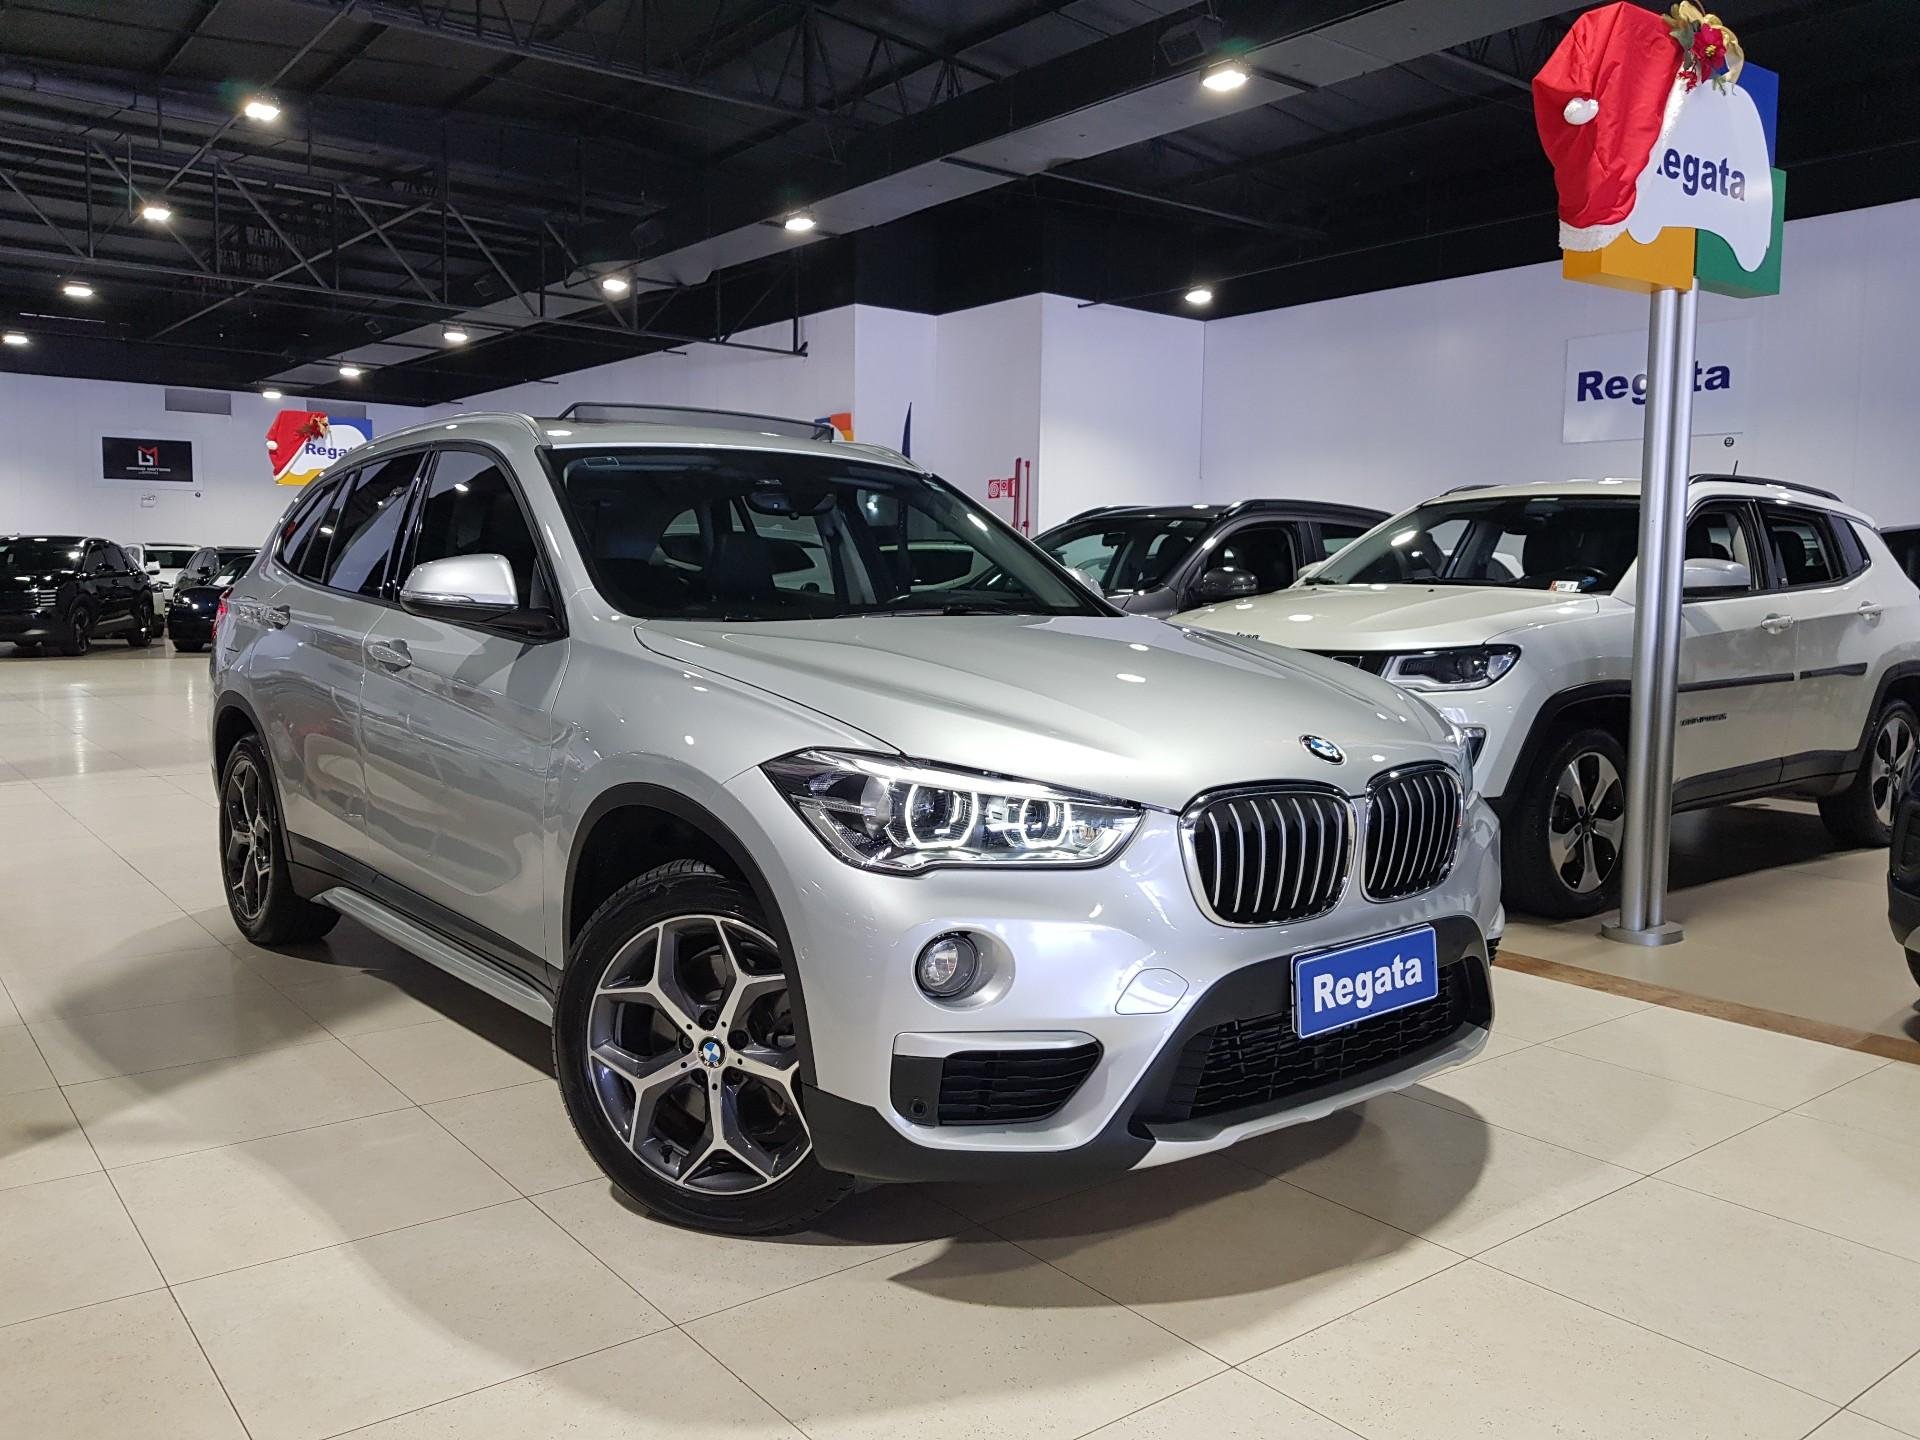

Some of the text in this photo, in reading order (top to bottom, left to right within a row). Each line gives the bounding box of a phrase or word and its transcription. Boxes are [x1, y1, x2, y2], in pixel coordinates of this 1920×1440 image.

[1656, 148, 1746, 202] egata
[1577, 360, 1731, 405] Regta
[305, 443, 353, 460] Rega
[1312, 953, 1424, 1013] Regata
